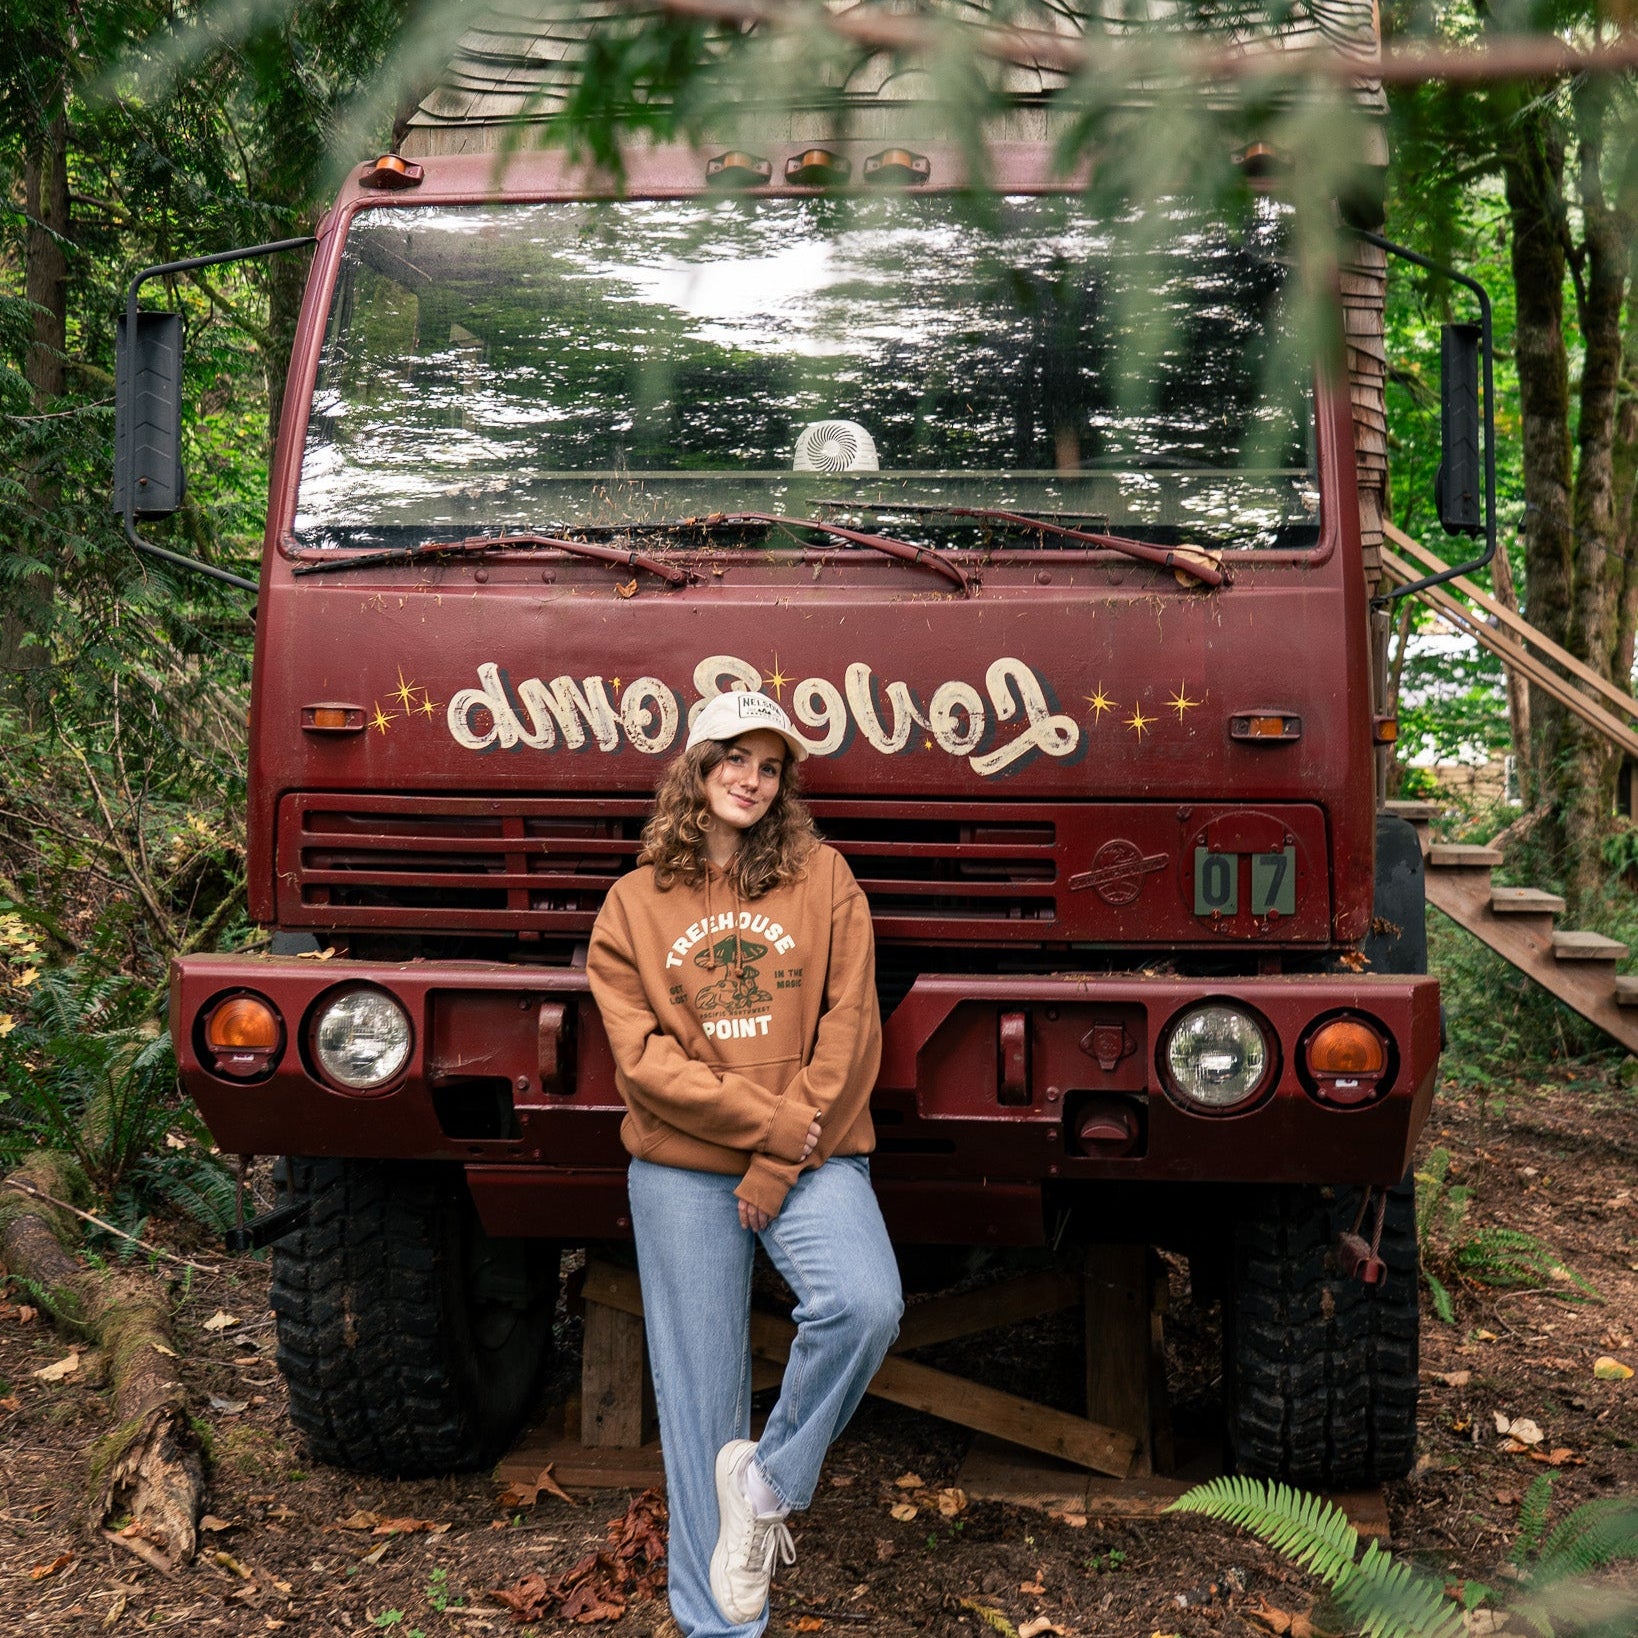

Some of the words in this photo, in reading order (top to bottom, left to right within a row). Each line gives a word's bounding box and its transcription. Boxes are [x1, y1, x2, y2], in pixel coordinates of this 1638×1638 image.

[665, 911, 796, 969] TREEHOUSE
[774, 970, 784, 979] IN
[788, 968, 803, 978] THE
[777, 979, 802, 989] MAGIC
[702, 1015, 772, 1040] POINT
